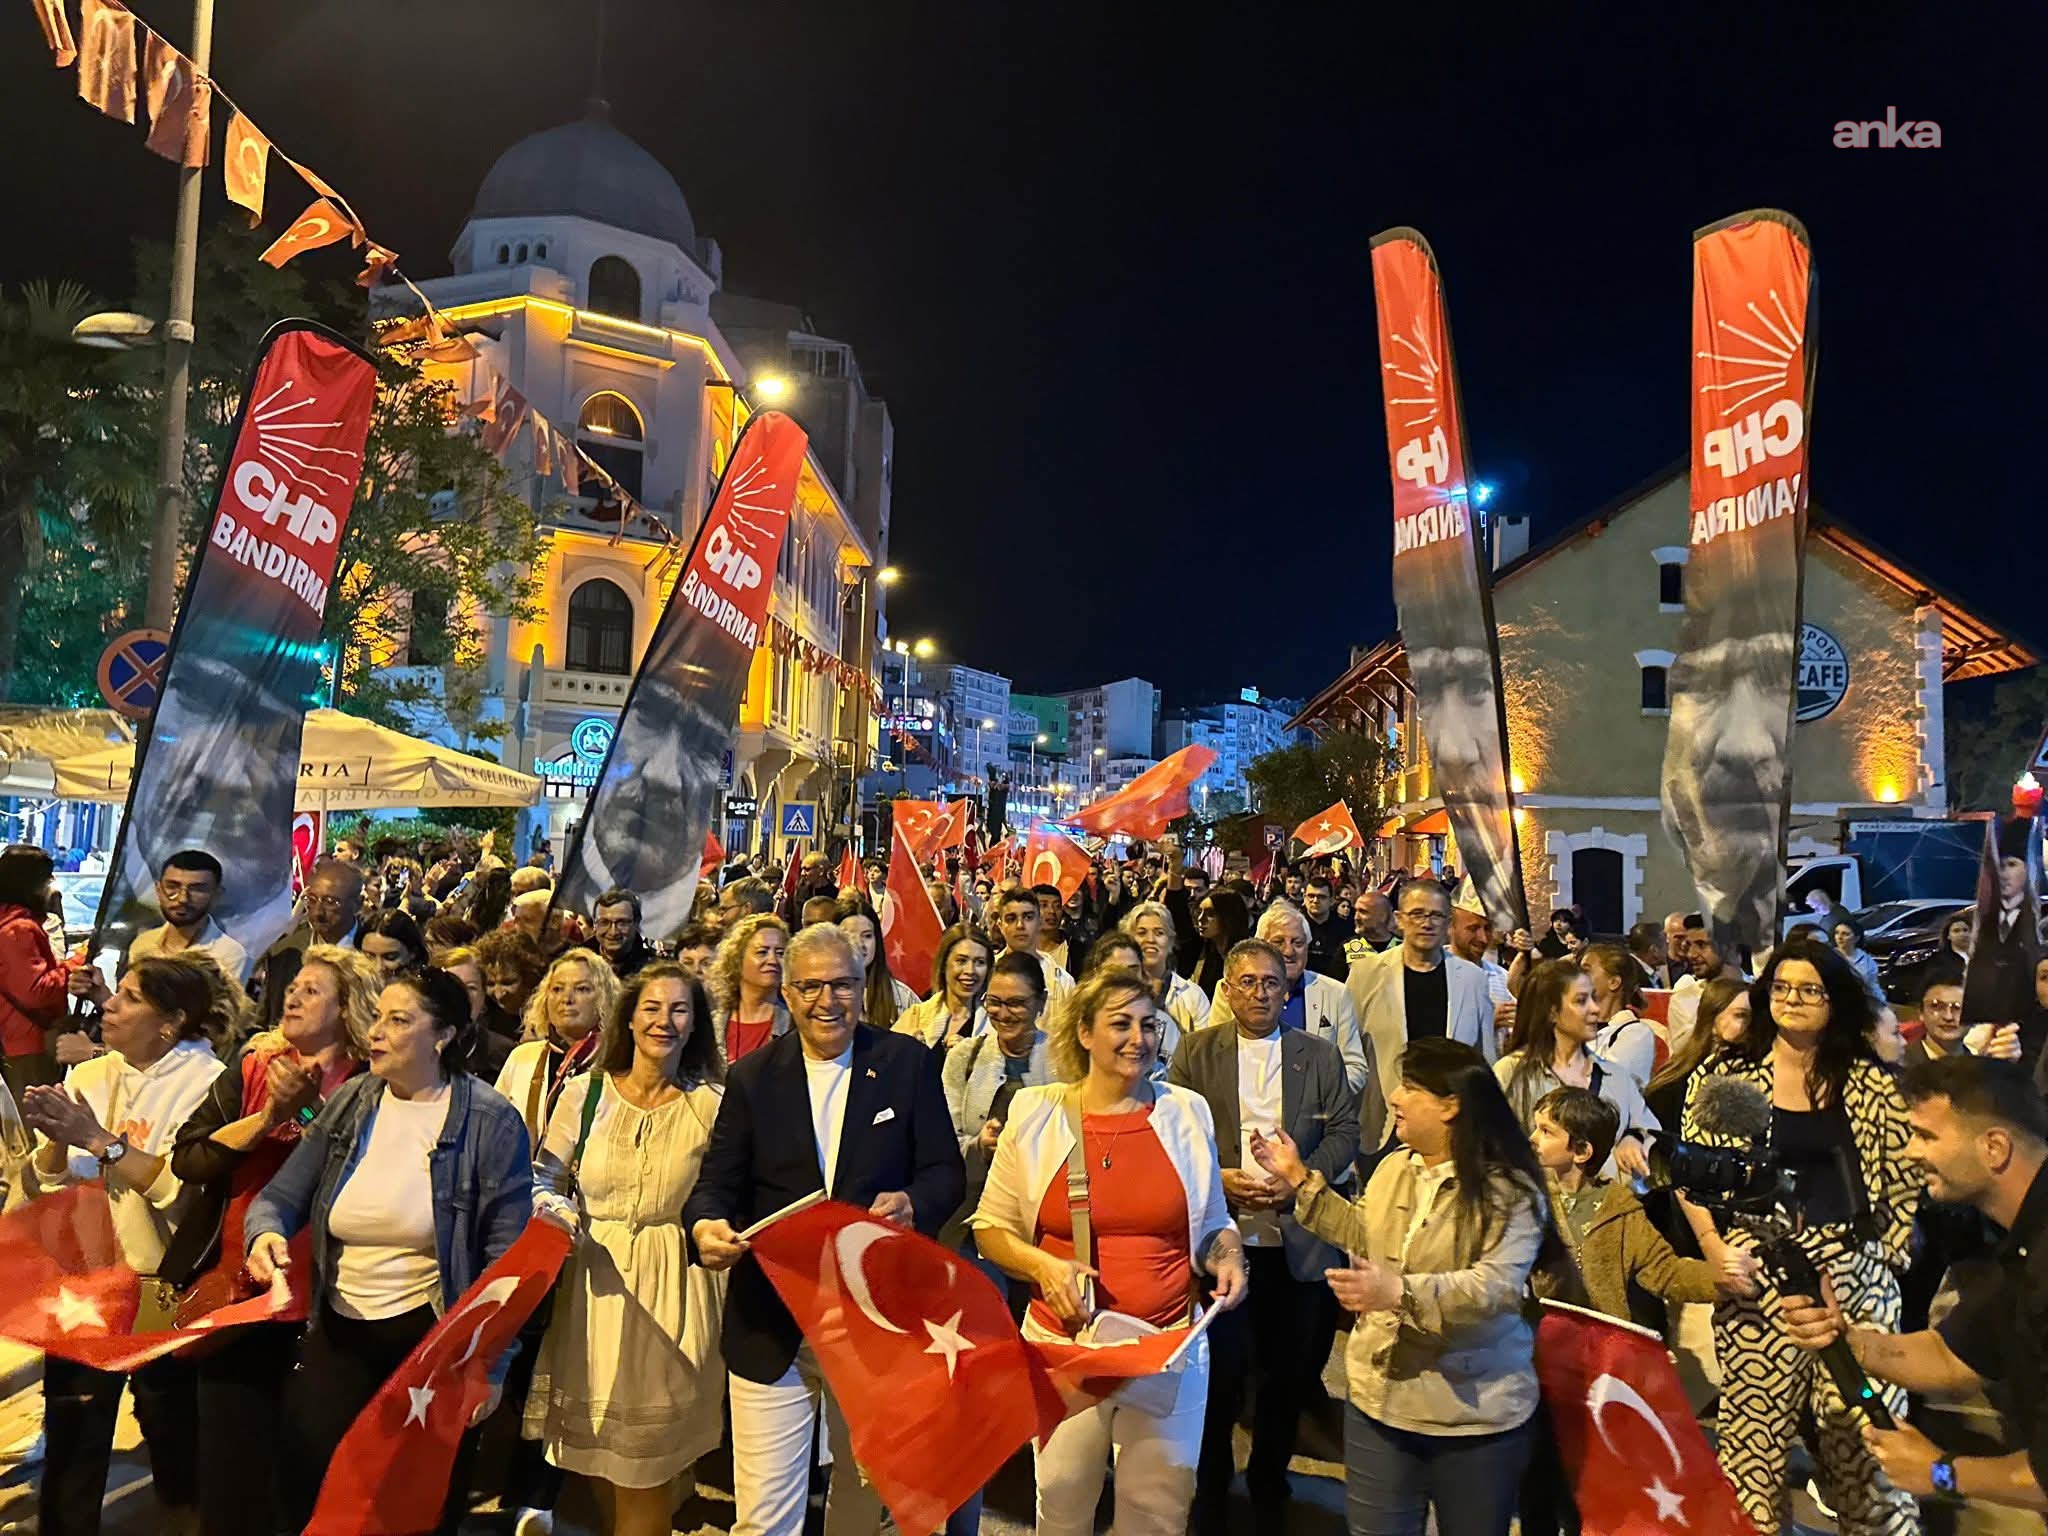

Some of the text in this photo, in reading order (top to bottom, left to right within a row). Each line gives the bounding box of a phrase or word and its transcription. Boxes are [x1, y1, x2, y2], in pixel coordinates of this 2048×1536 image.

[233, 460, 338, 547] CHP
[211, 511, 329, 620] BANDIRMA
[704, 524, 762, 592] CHP
